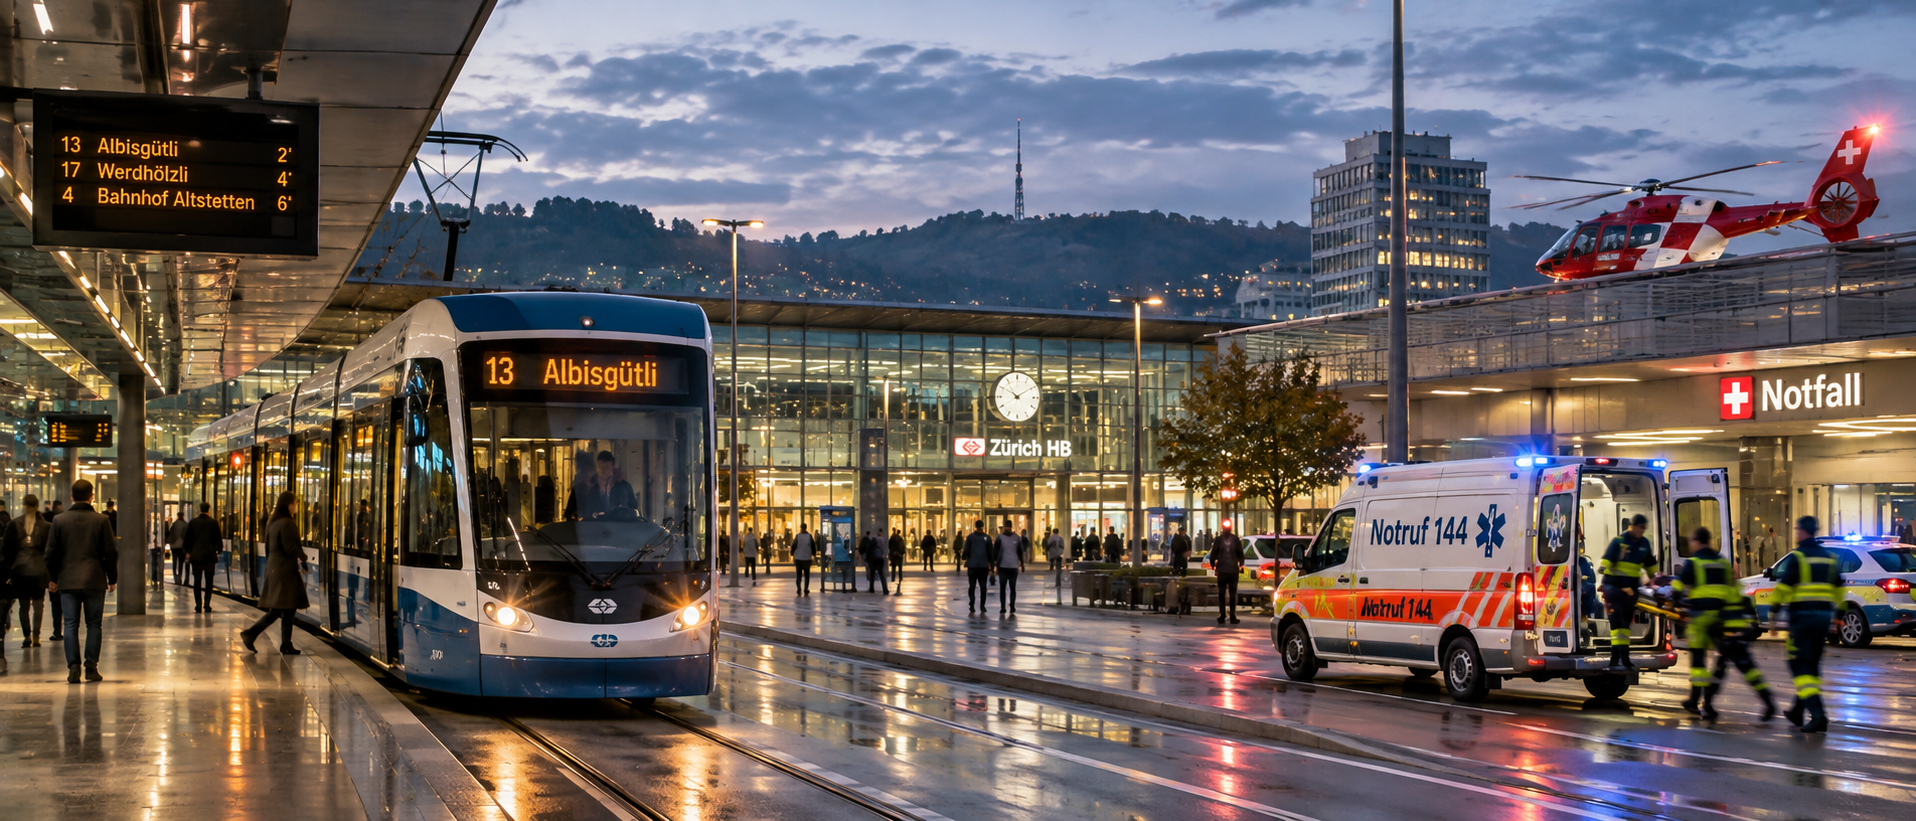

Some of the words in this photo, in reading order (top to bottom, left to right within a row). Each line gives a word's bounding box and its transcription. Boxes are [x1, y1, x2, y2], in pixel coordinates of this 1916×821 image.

[61, 136, 81, 153] 13
[97, 138, 179, 160] Albisgütli
[61, 161, 81, 178] 17
[96, 163, 188, 183] Werdhölzli
[61, 186, 74, 204] 4
[97, 188, 170, 207] Bahnhof
[172, 191, 255, 211] Altstetten
[486, 357, 514, 385] 13
[542, 359, 657, 392] Albisgütli
[1762, 373, 1860, 412] Notfall
[989, 439, 1042, 457] Zürich
[1047, 440, 1072, 458] HB
[1370, 516, 1431, 546] Notruf
[1434, 516, 1468, 546] 144
